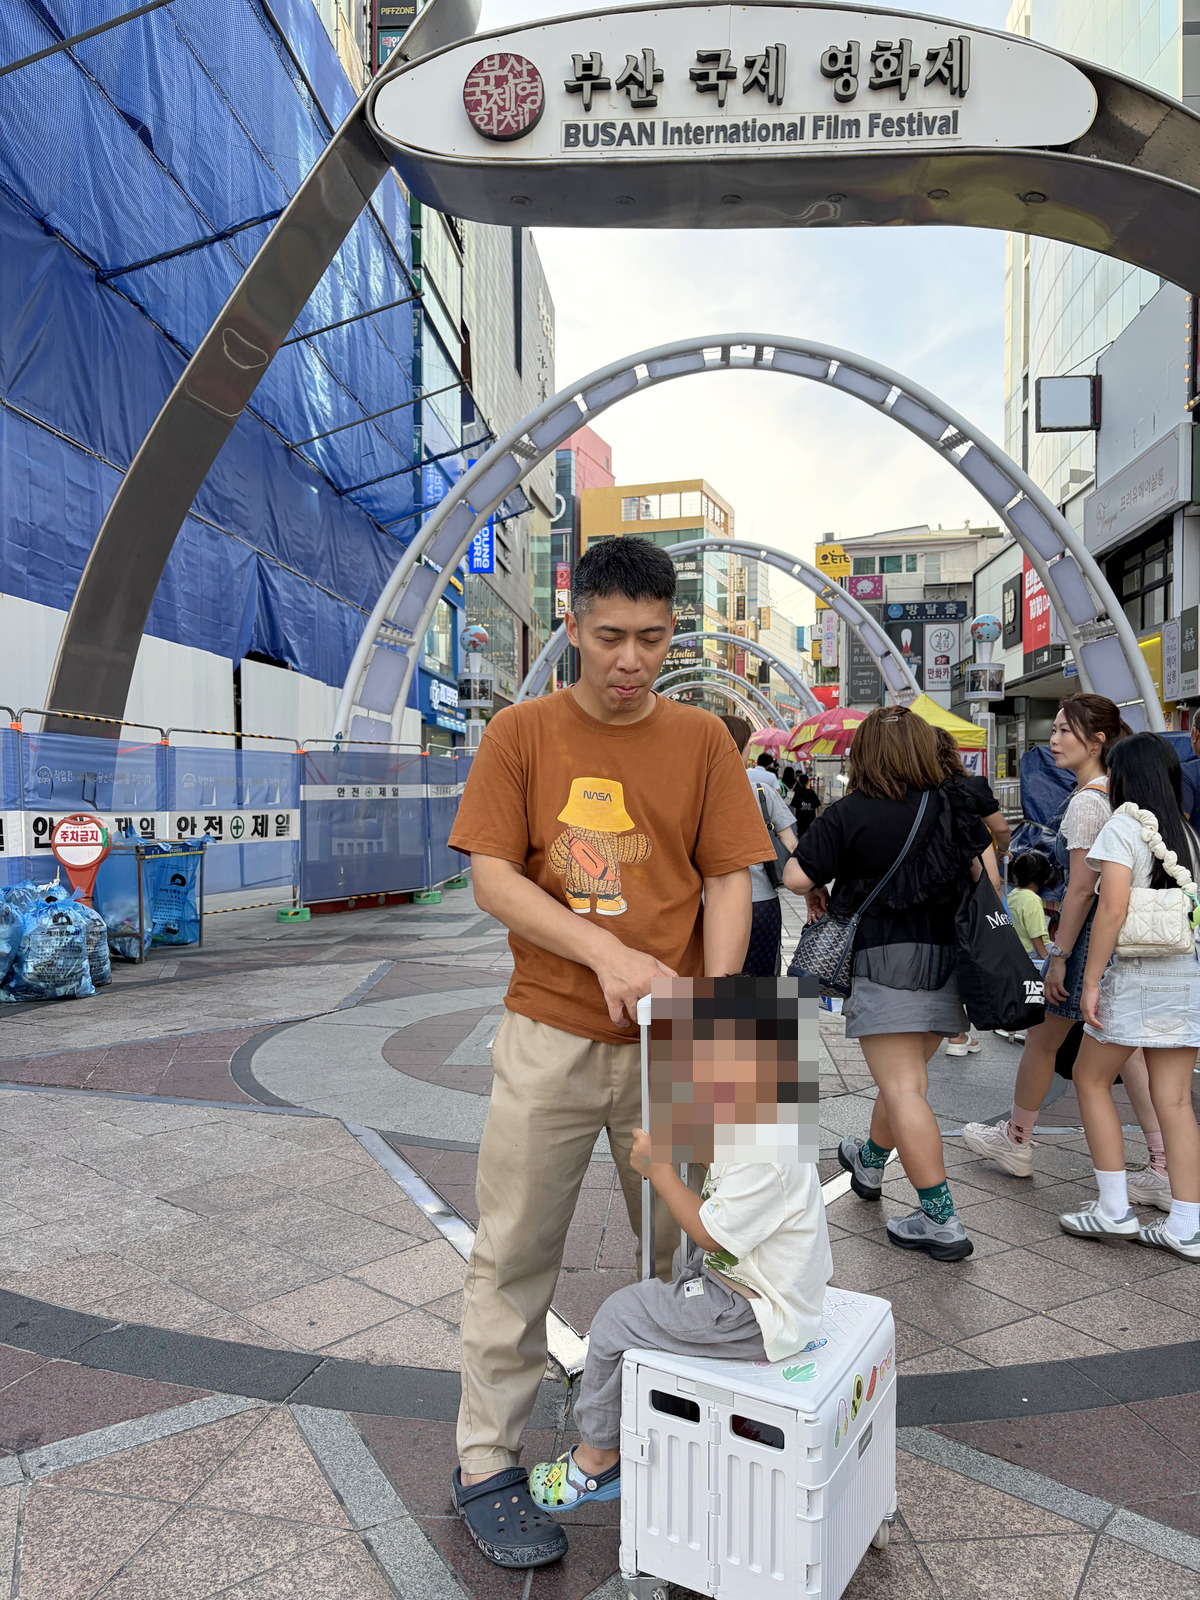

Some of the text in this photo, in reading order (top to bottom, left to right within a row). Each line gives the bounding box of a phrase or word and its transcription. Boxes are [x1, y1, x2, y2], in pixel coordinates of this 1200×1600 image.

[381, 6, 415, 15] PIFFZONE
[564, 35, 972, 112] 부산 국제 영화제
[564, 109, 959, 148] BUSAN International Film Festival
[473, 529, 482, 569] ORE
[482, 524, 490, 569] OUNG
[906, 604, 958, 615] 방탈출
[928, 667, 950, 680] 만화카
[583, 790, 612, 802] NASA
[251, 814, 291, 838] 제일
[60, 830, 99, 843] 주차금지
